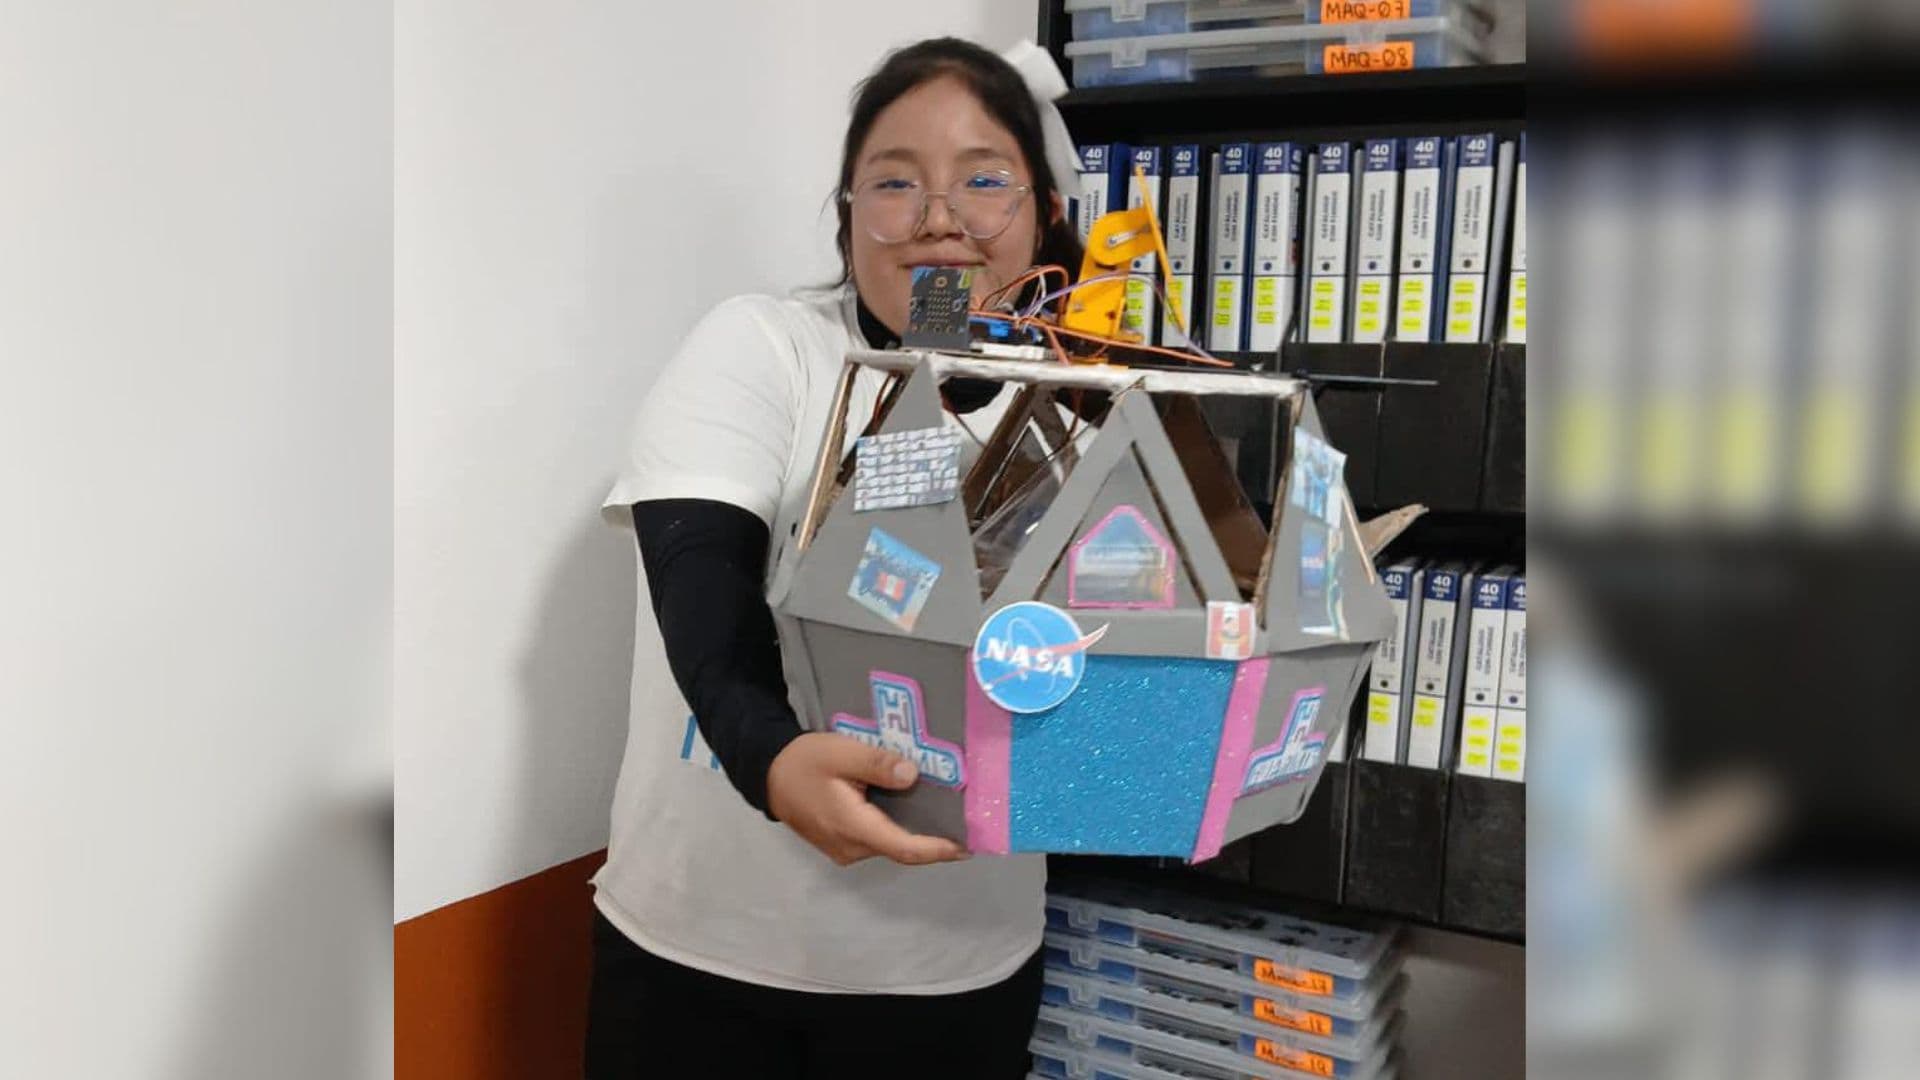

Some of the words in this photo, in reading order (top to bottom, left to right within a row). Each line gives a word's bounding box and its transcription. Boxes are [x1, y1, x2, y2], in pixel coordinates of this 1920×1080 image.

[1330, 47, 1409, 69] MAQ-08
[1370, 144, 1390, 156] 40
[1415, 140, 1434, 153] 40
[1467, 138, 1486, 151] 40
[1085, 148, 1103, 159] 40
[1135, 150, 1152, 161] 40
[1175, 150, 1192, 161] 40
[1225, 147, 1242, 159] 40
[1264, 146, 1282, 158] 40
[1323, 145, 1341, 158] 40
[1385, 573, 1403, 585] 40
[1433, 575, 1451, 587] 40
[1480, 583, 1499, 595] 40
[984, 637, 1074, 678] NASA
